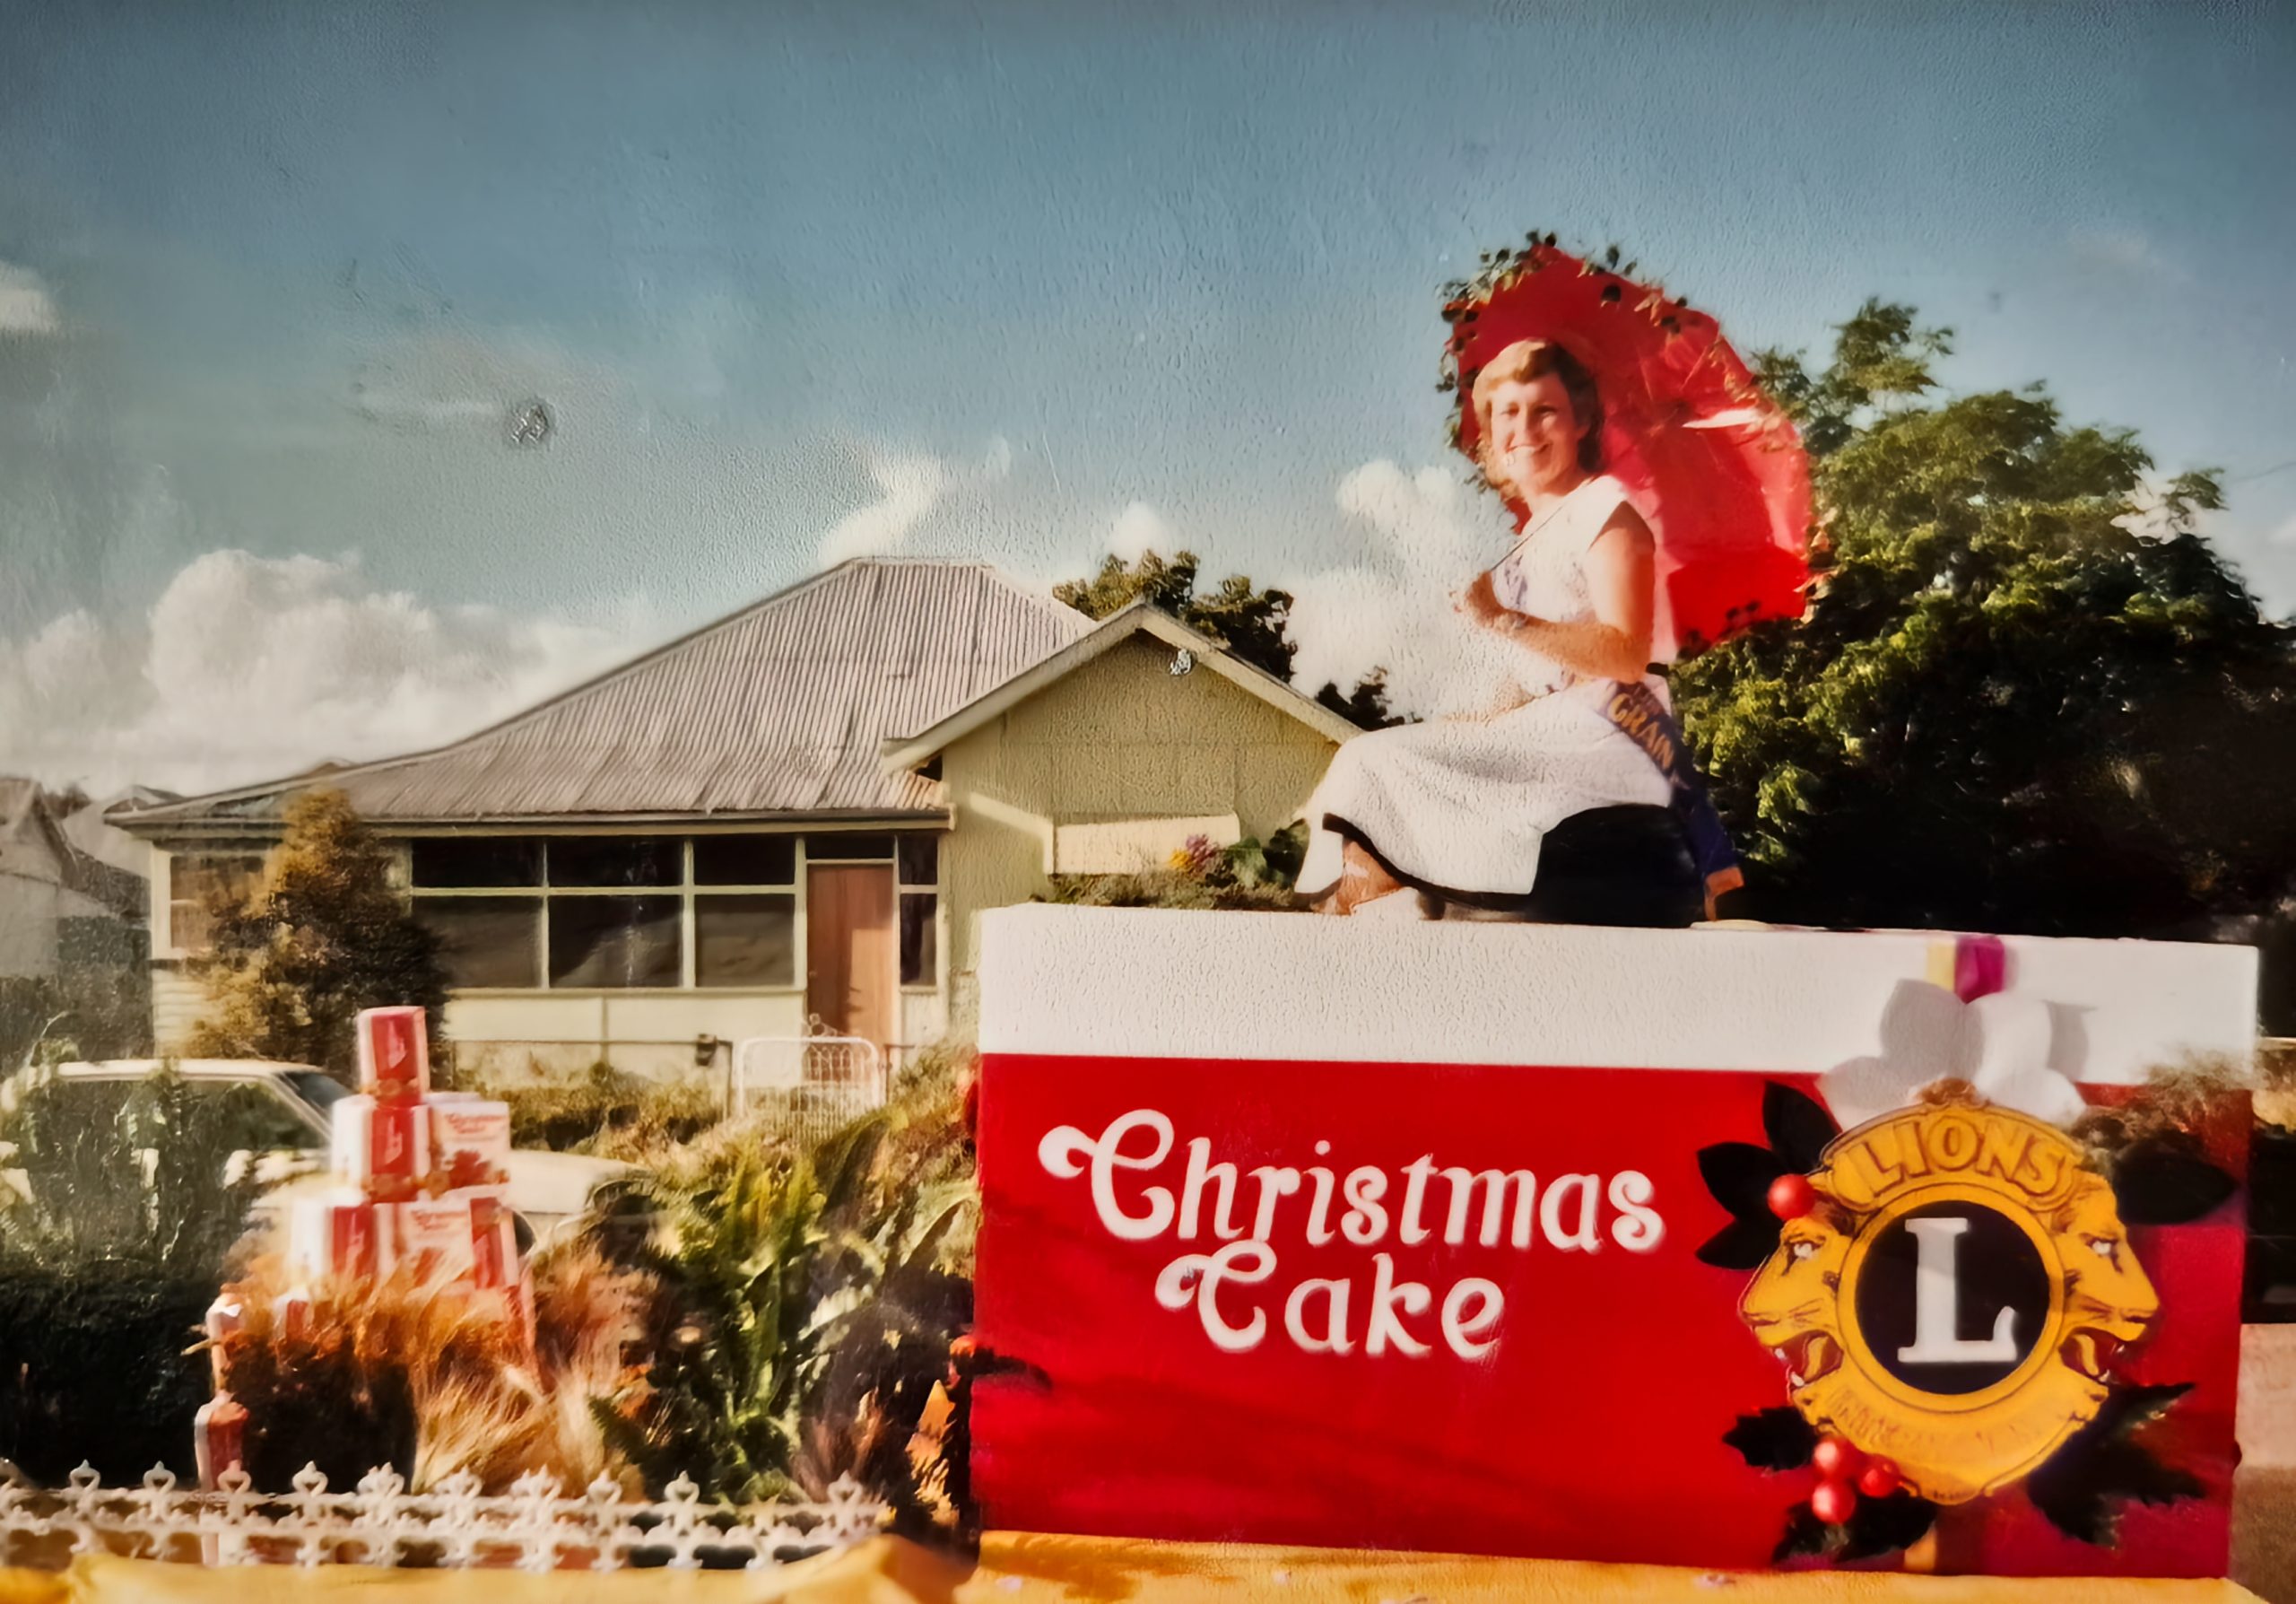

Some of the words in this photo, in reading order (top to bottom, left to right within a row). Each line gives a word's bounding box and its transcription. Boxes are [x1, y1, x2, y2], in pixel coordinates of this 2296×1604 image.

[1038, 1108, 1665, 1253] Christmas
[1847, 1115, 2066, 1199] LIONS
[1154, 1239, 1506, 1361] Cake
[1897, 1216, 2018, 1363] L
